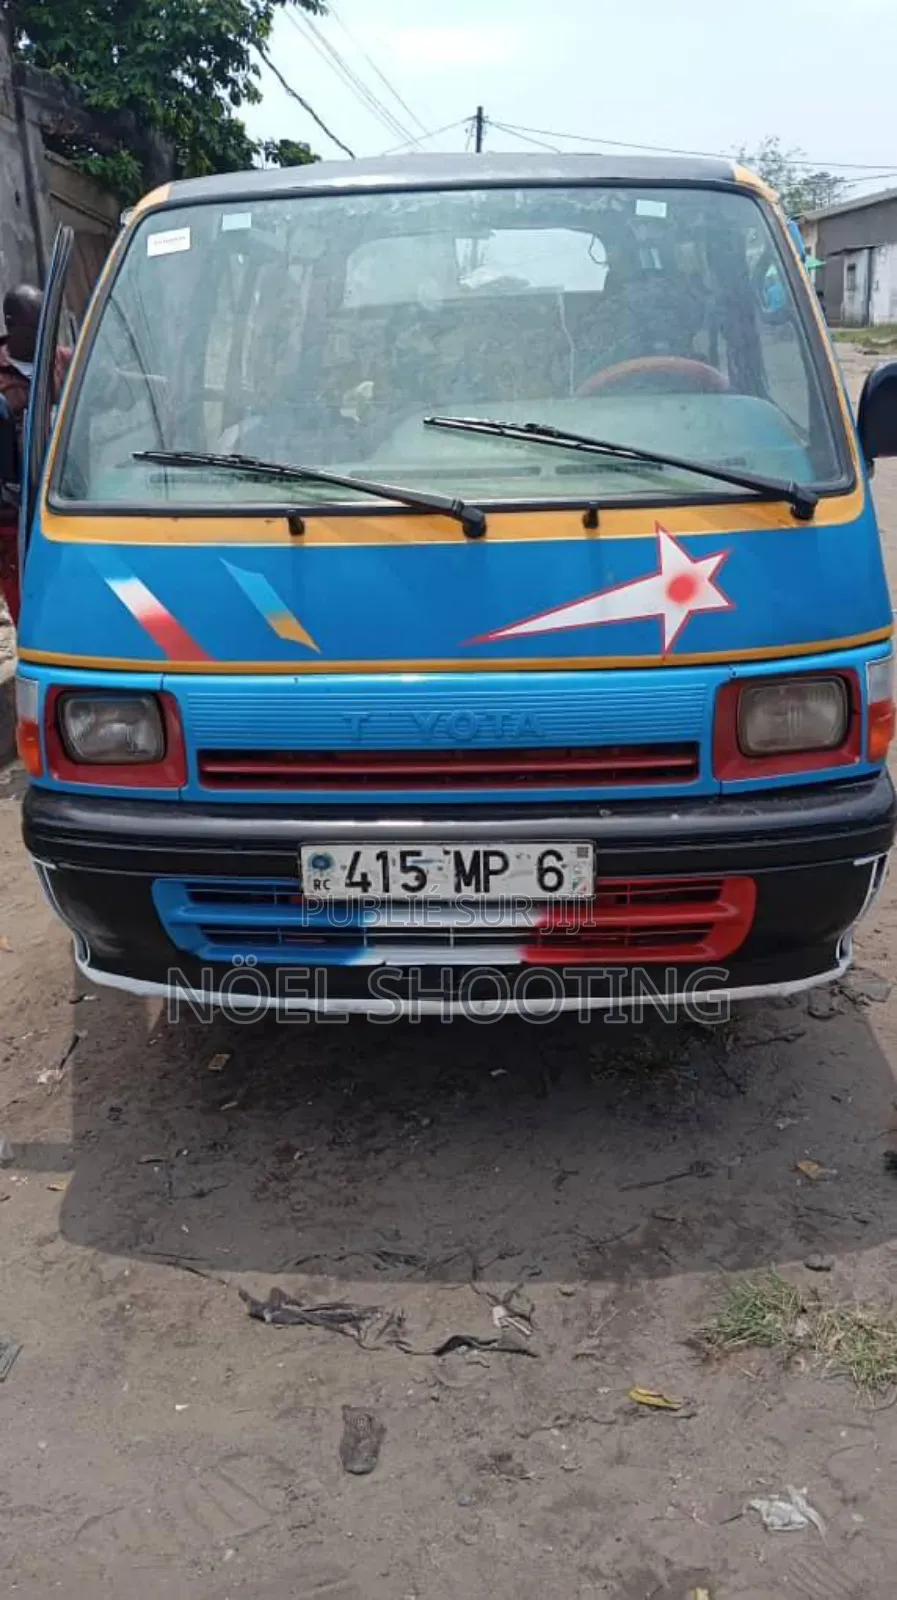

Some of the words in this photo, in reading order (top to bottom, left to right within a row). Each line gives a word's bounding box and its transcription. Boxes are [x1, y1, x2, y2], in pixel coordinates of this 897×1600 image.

[313, 878, 331, 891] RC
[344, 850, 428, 893] 415
[452, 850, 510, 893] MP
[536, 849, 565, 893] 6
